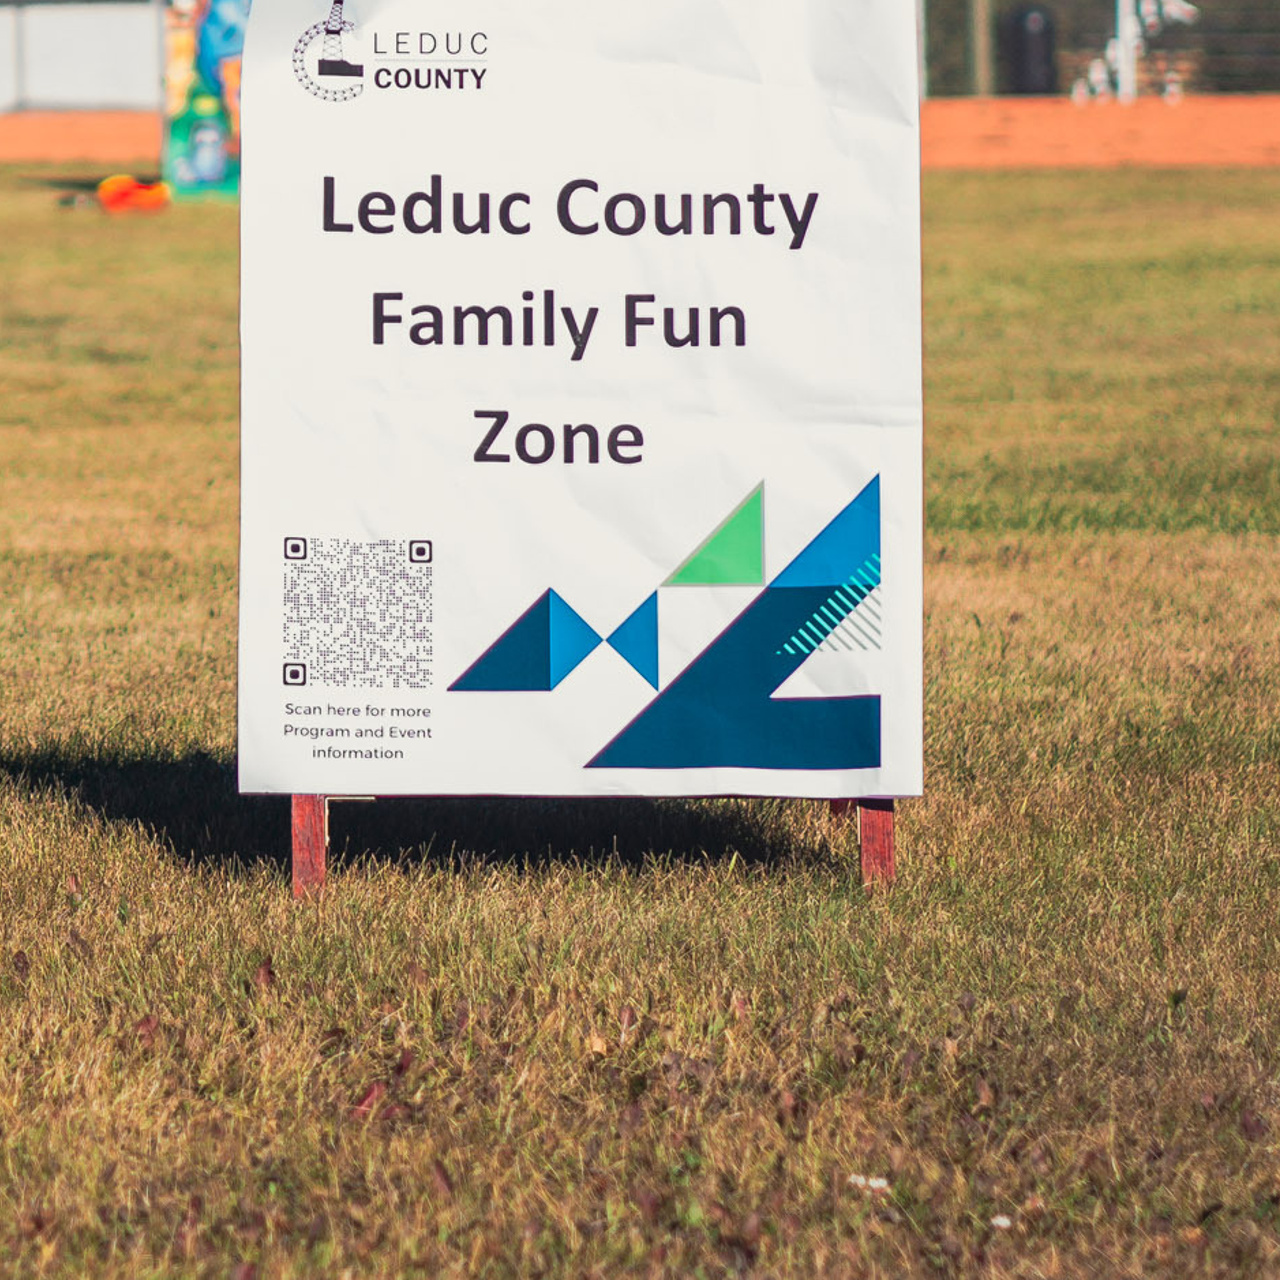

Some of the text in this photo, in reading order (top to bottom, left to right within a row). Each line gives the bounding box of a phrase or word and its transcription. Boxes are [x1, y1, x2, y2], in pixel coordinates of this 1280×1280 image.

[374, 31, 489, 55] LEDUC
[374, 67, 487, 90] COUNTY
[322, 174, 819, 250] Leduc County
[372, 290, 746, 361] Family Fun
[473, 410, 644, 464] Zone
[284, 703, 432, 718] Scan here for more
[283, 724, 432, 739] Program and Event
[312, 746, 404, 759] information
